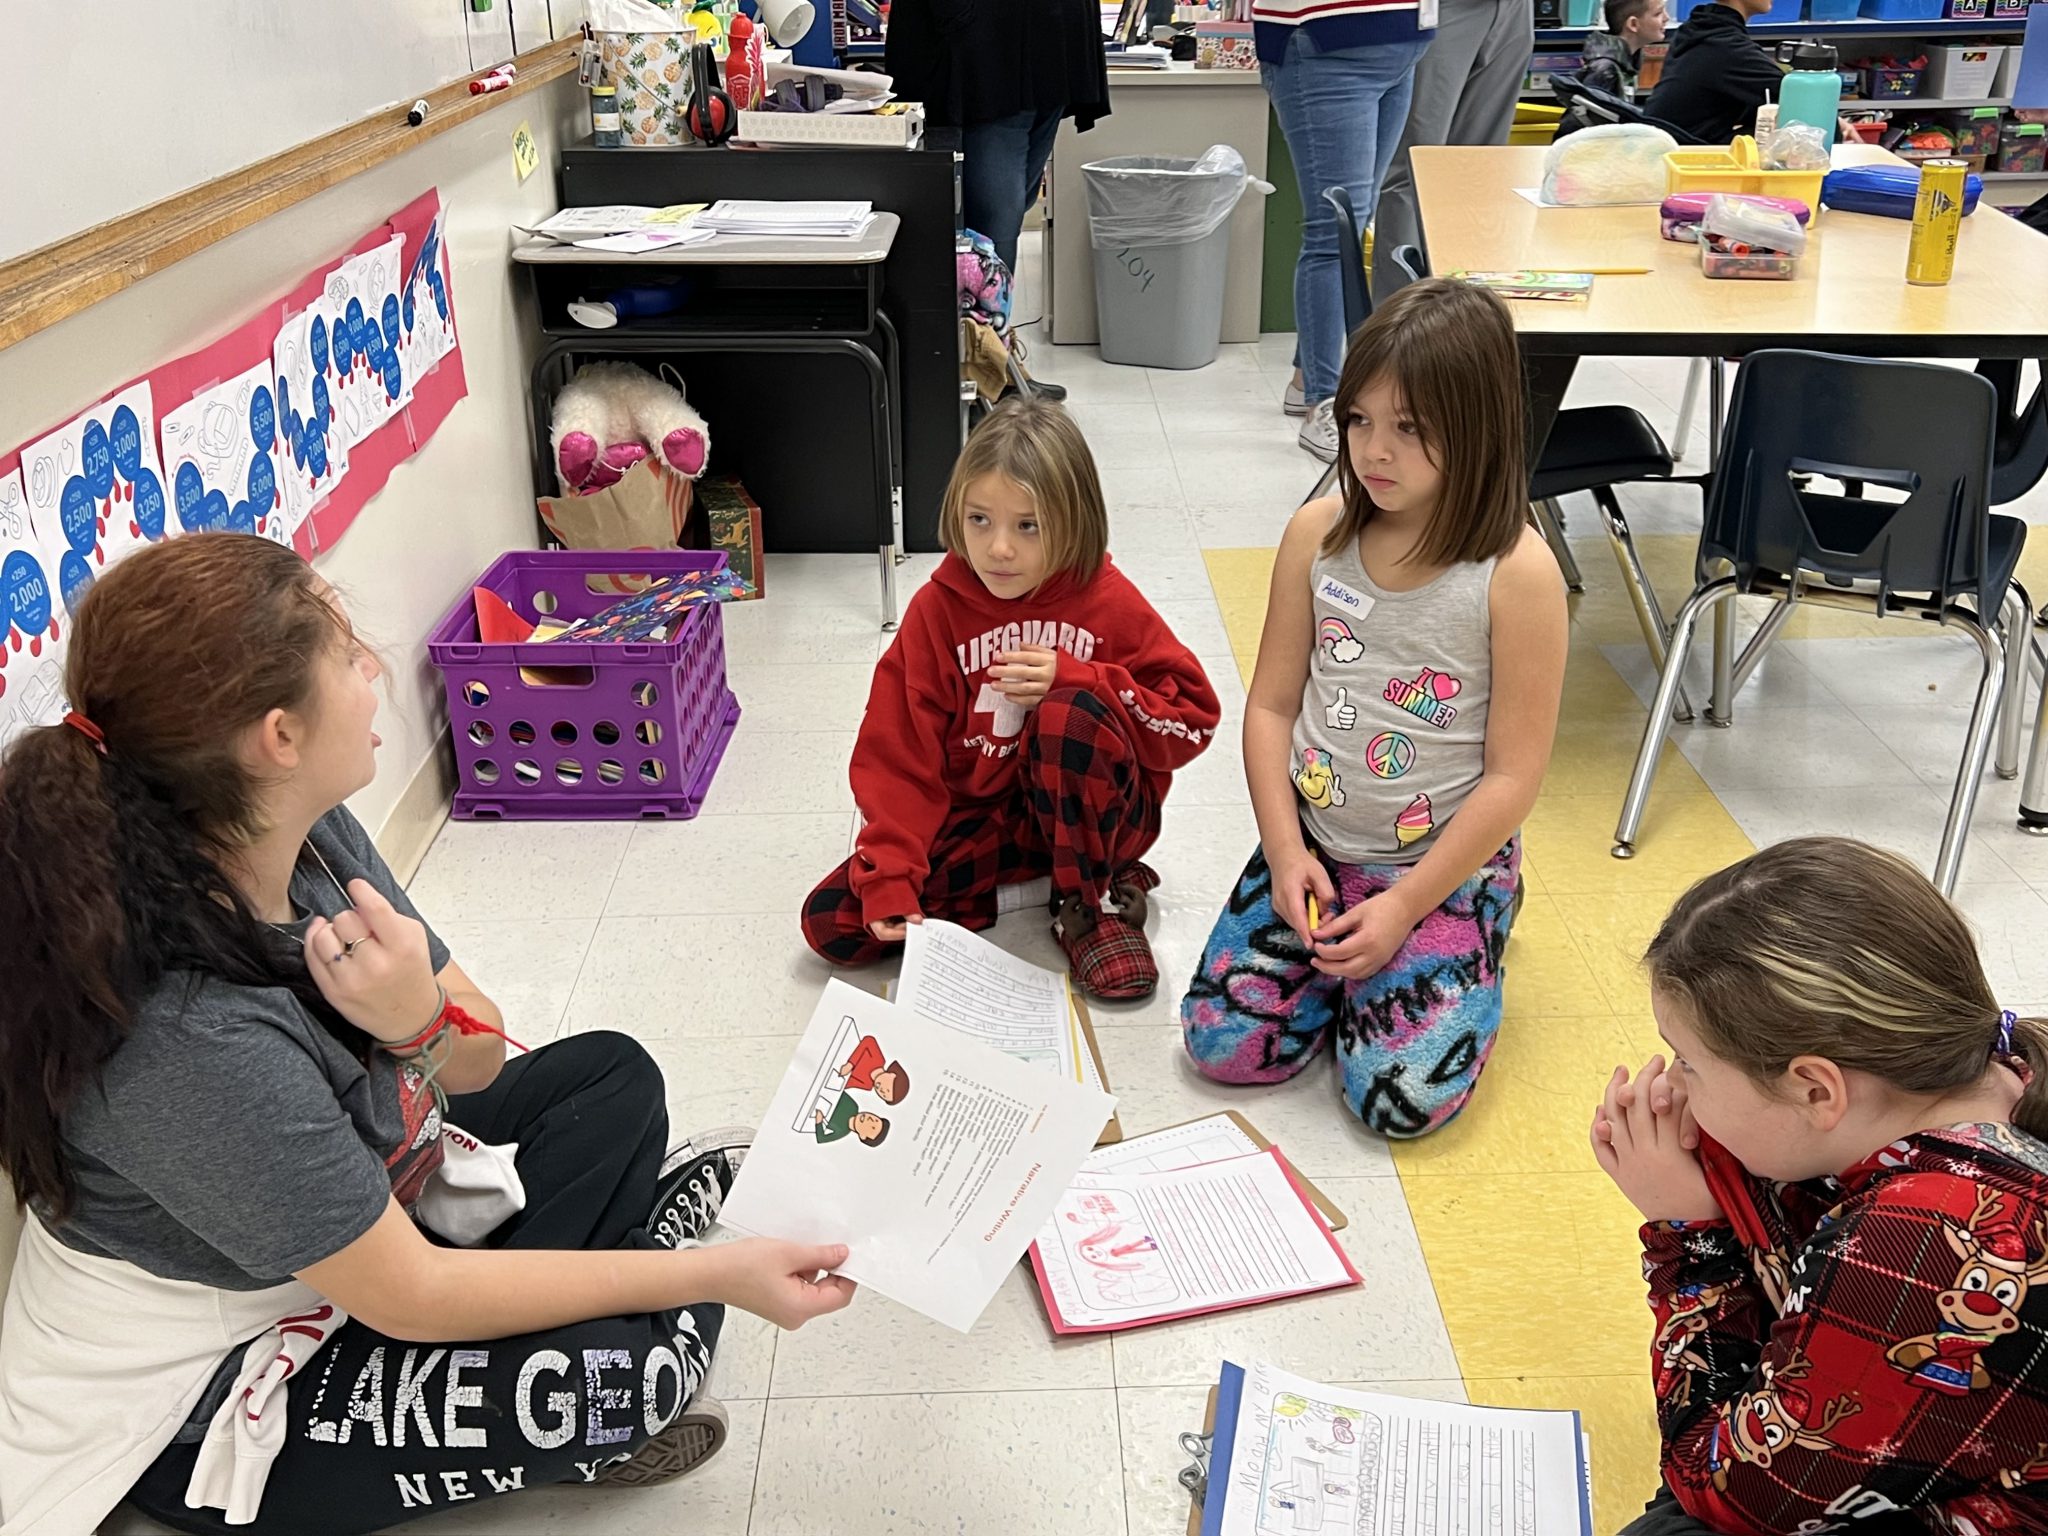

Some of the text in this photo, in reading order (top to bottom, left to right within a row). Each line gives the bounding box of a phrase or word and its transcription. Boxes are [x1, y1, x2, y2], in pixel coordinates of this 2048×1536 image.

[253, 407, 273, 433] 5,500
[87, 446, 109, 475] 2,750
[113, 431, 137, 459] 3,000
[179, 485, 200, 513] 3,500
[251, 473, 272, 498] 5,000
[65, 502, 93, 533] 2,500
[137, 491, 161, 520] 3,250
[10, 577, 43, 613] 2,000
[1322, 581, 1359, 608] Addison
[957, 620, 1094, 676] LIFEGUARD
[1383, 677, 1457, 730] SUMMER
[1009, 1163, 1041, 1206] Narrative
[984, 1208, 1012, 1242] Writing
[305, 1309, 711, 1449] LAKE GEO
[395, 1466, 525, 1508] NEW
